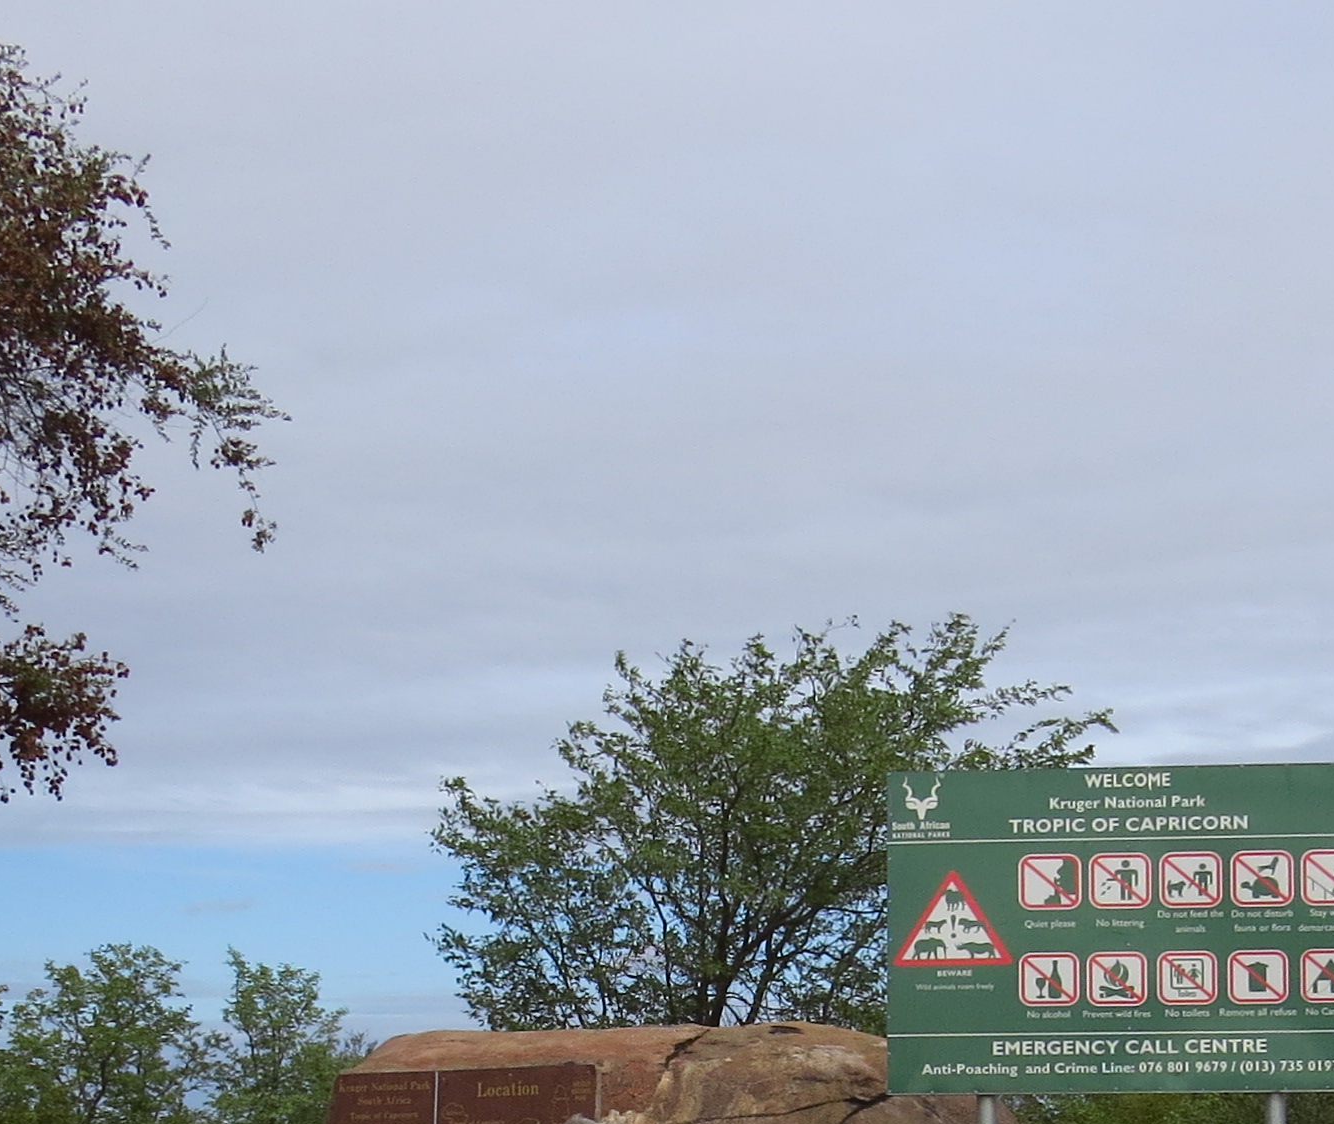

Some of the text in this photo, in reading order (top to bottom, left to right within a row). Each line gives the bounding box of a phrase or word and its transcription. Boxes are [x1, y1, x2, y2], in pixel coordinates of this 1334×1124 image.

[1084, 773, 1172, 789] WELCOME
[1048, 795, 1205, 812] Kruger National Park
[892, 821, 950, 830] South African
[1009, 815, 1249, 834] TROPIC OF CAPRICORN
[1157, 910, 1170, 918] Do
[1189, 909, 1207, 917] feed
[1209, 909, 1224, 917] the
[1231, 910, 1244, 918] Do
[1309, 908, 1326, 919] Stay
[1024, 919, 1076, 929] Quiet please
[1096, 918, 1144, 929] No littering
[937, 969, 972, 977] BEWARE
[1027, 1009, 1071, 1019] No alcohol
[1115, 1008, 1131, 1017] wild
[1133, 1008, 1151, 1017] fires
[1165, 1008, 1209, 1018] No toilets
[1219, 1008, 1296, 1017] Remove all refuse
[1305, 1008, 1320, 1016] No
[992, 1038, 1268, 1056] EMERGENCY CALL CENTRE
[921, 1062, 1018, 1077] Anti-Poaching
[1025, 1063, 1050, 1075] and
[1054, 1062, 1096, 1074] Crime
[1101, 1061, 1135, 1073] Line:
[1138, 1061, 1160, 1073] 076
[1166, 1060, 1190, 1072] 801
[1194, 1060, 1227, 1072] 9679
[1240, 1060, 1274, 1074] (013)
[1280, 1060, 1303, 1071] 735
[477, 1081, 539, 1098] Location
